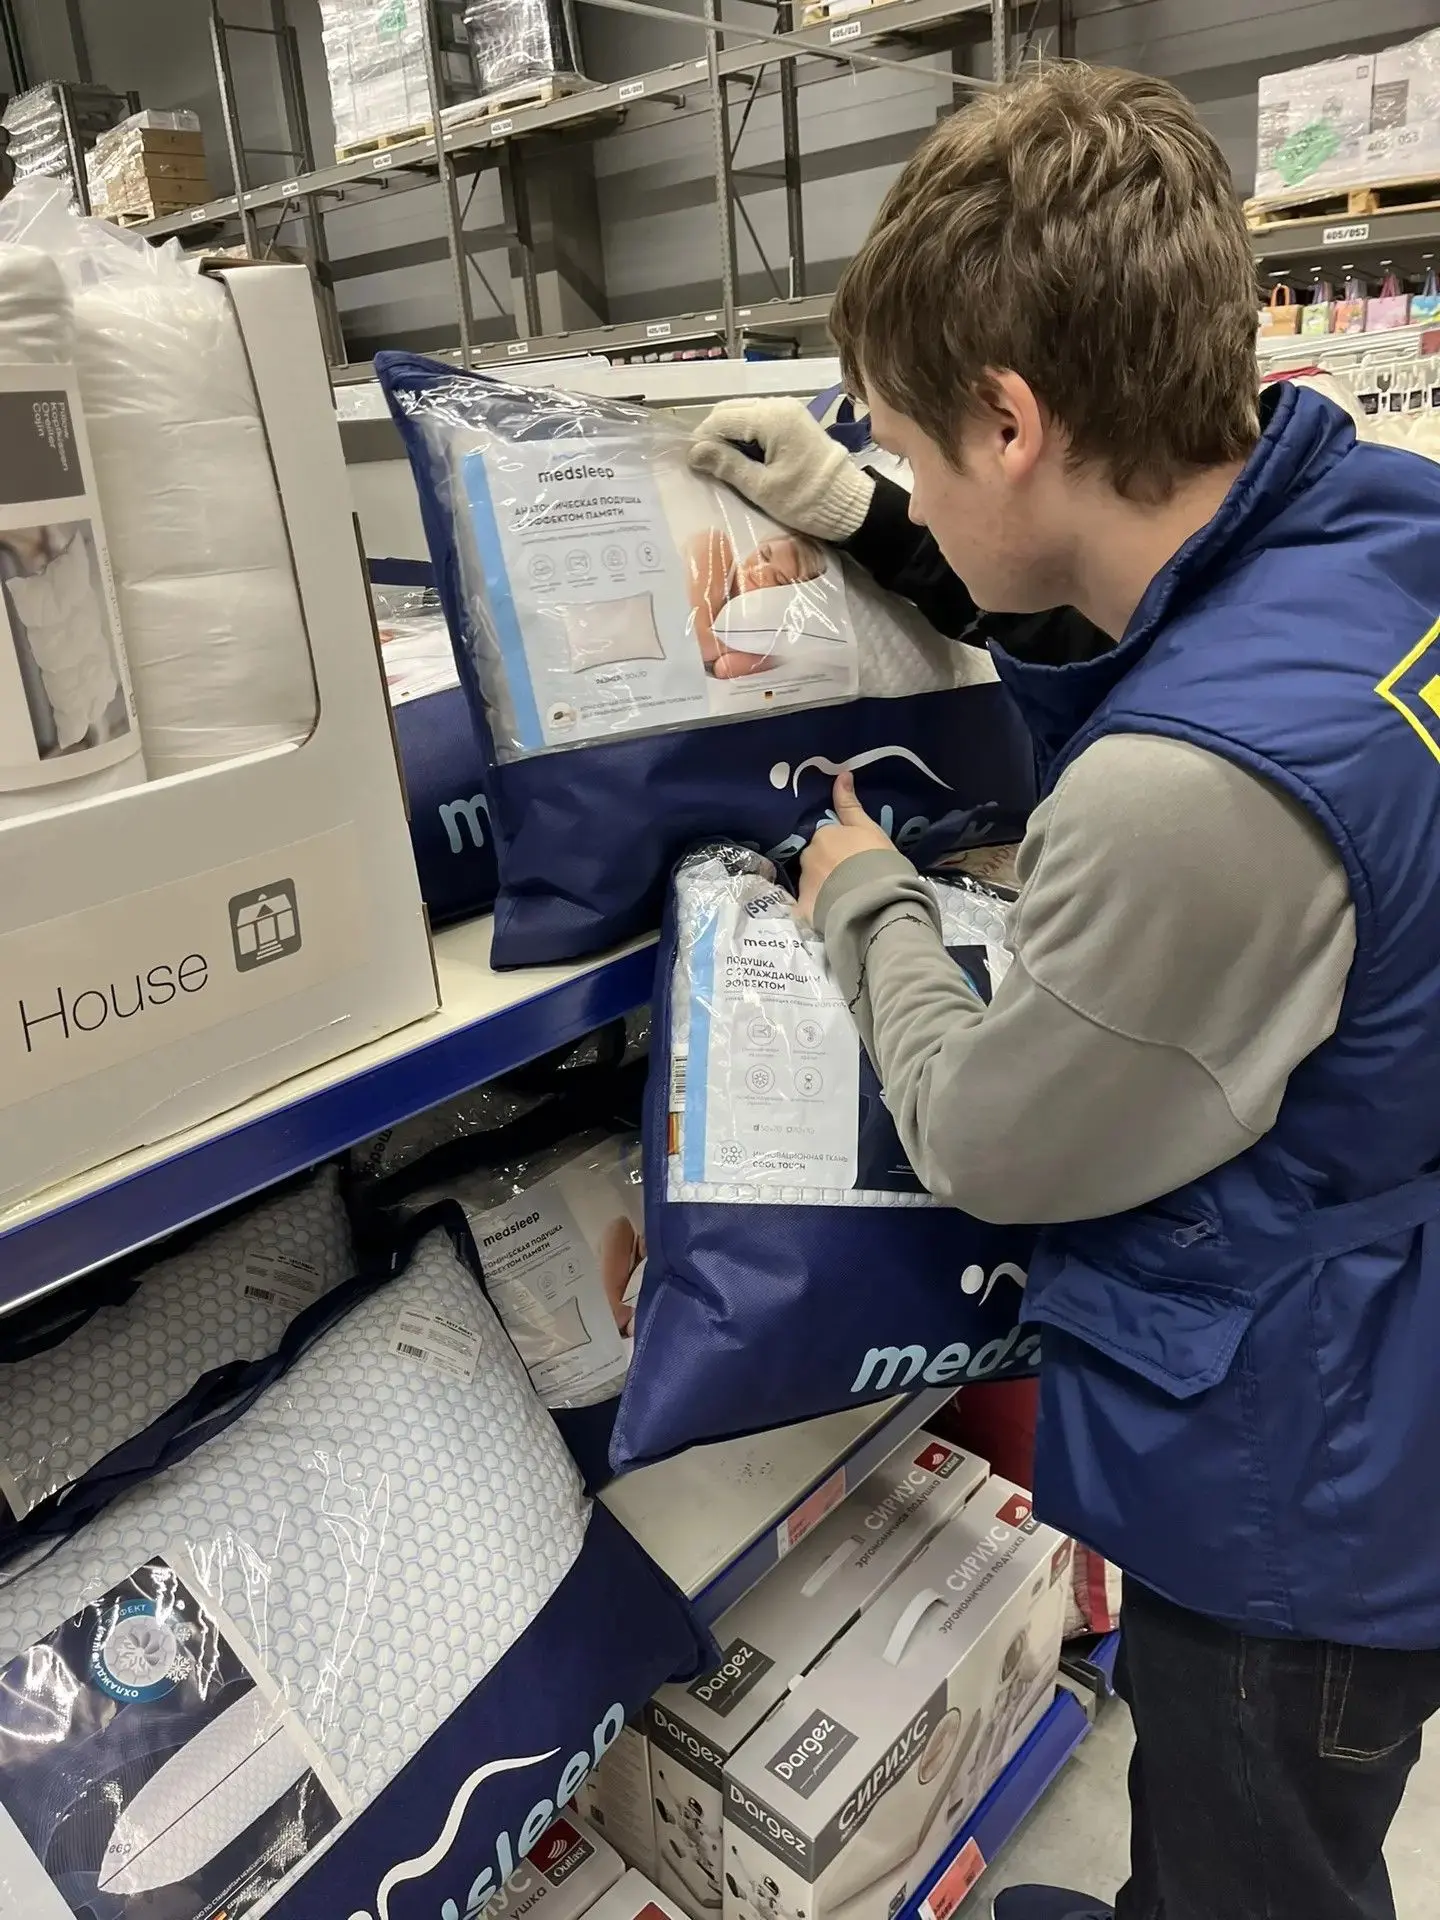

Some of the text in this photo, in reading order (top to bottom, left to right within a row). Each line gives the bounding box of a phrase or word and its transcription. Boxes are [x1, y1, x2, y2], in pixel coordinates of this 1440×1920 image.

[538, 465, 615, 483] medsleep
[726, 955, 775, 969] ПОДУШКА
[18, 953, 209, 1052] House
[483, 1211, 541, 1247] medsleep
[864, 1470, 927, 1531] СИРИУС
[946, 1525, 1011, 1592] СИРИУС
[991, 1535, 1026, 1573] подушка
[695, 1646, 754, 1701] Dargez
[654, 1709, 725, 1770] Dargez
[774, 1719, 836, 1780] Dargez
[838, 1711, 929, 1831] СИРИУС
[441, 1703, 625, 1920] sleep
[730, 1784, 806, 1856] Dargez
[553, 1846, 587, 1878] Outlast
